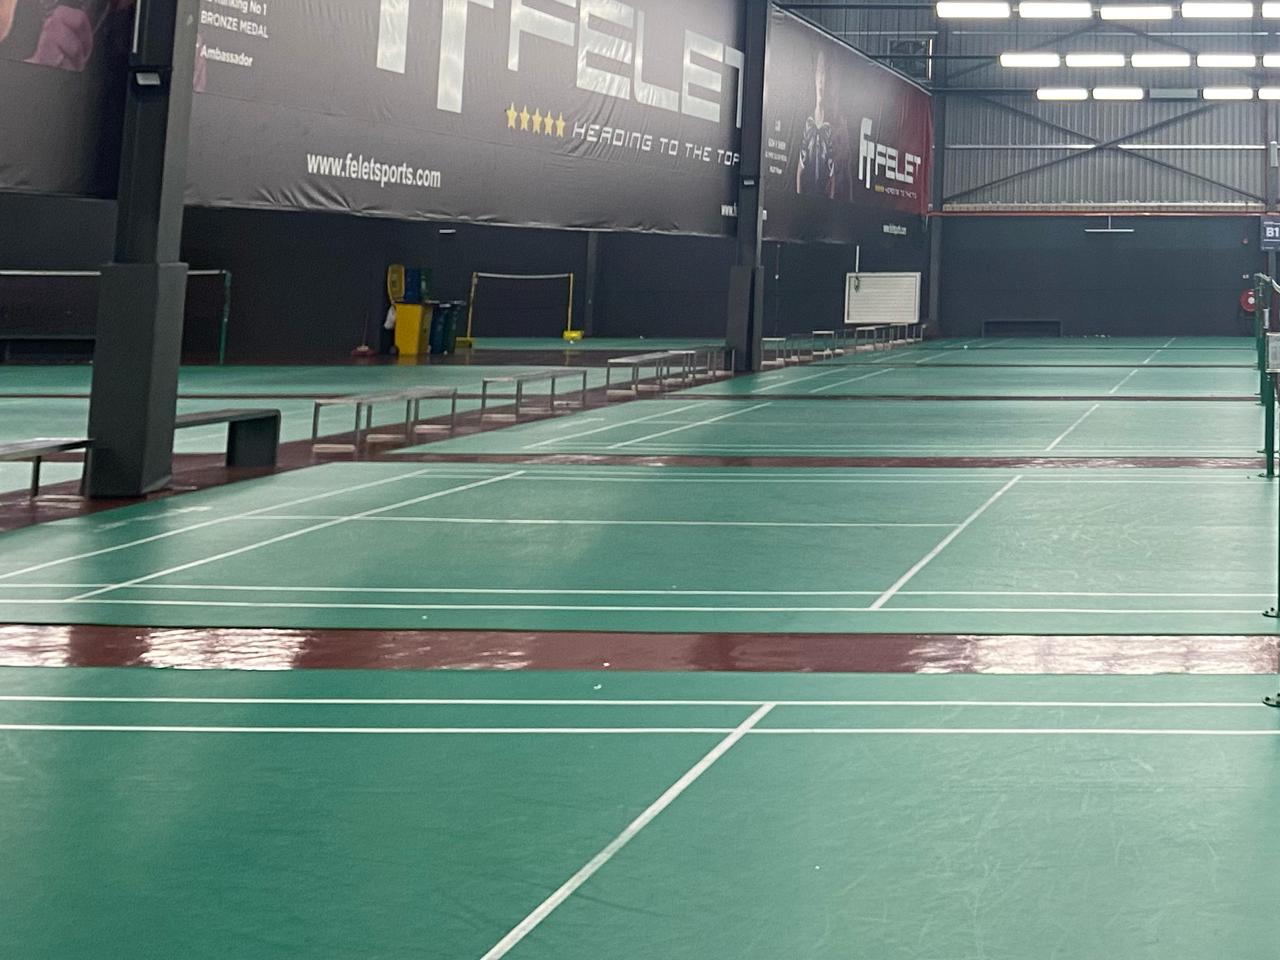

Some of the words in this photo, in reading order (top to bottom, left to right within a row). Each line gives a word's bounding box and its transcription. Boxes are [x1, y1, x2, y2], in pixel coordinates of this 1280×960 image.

[249, 1, 262, 15] No
[200, 10, 239, 31] BRONZE
[239, 18, 269, 38] MEDAL
[200, 44, 254, 67] Ambassador
[572, 122, 653, 151] HEADING
[660, 137, 679, 155] TO
[685, 142, 712, 162] THE
[307, 152, 441, 188] www.feletsports.com
[875, 143, 922, 184] FELET
[1265, 227, 1280, 238] B1
